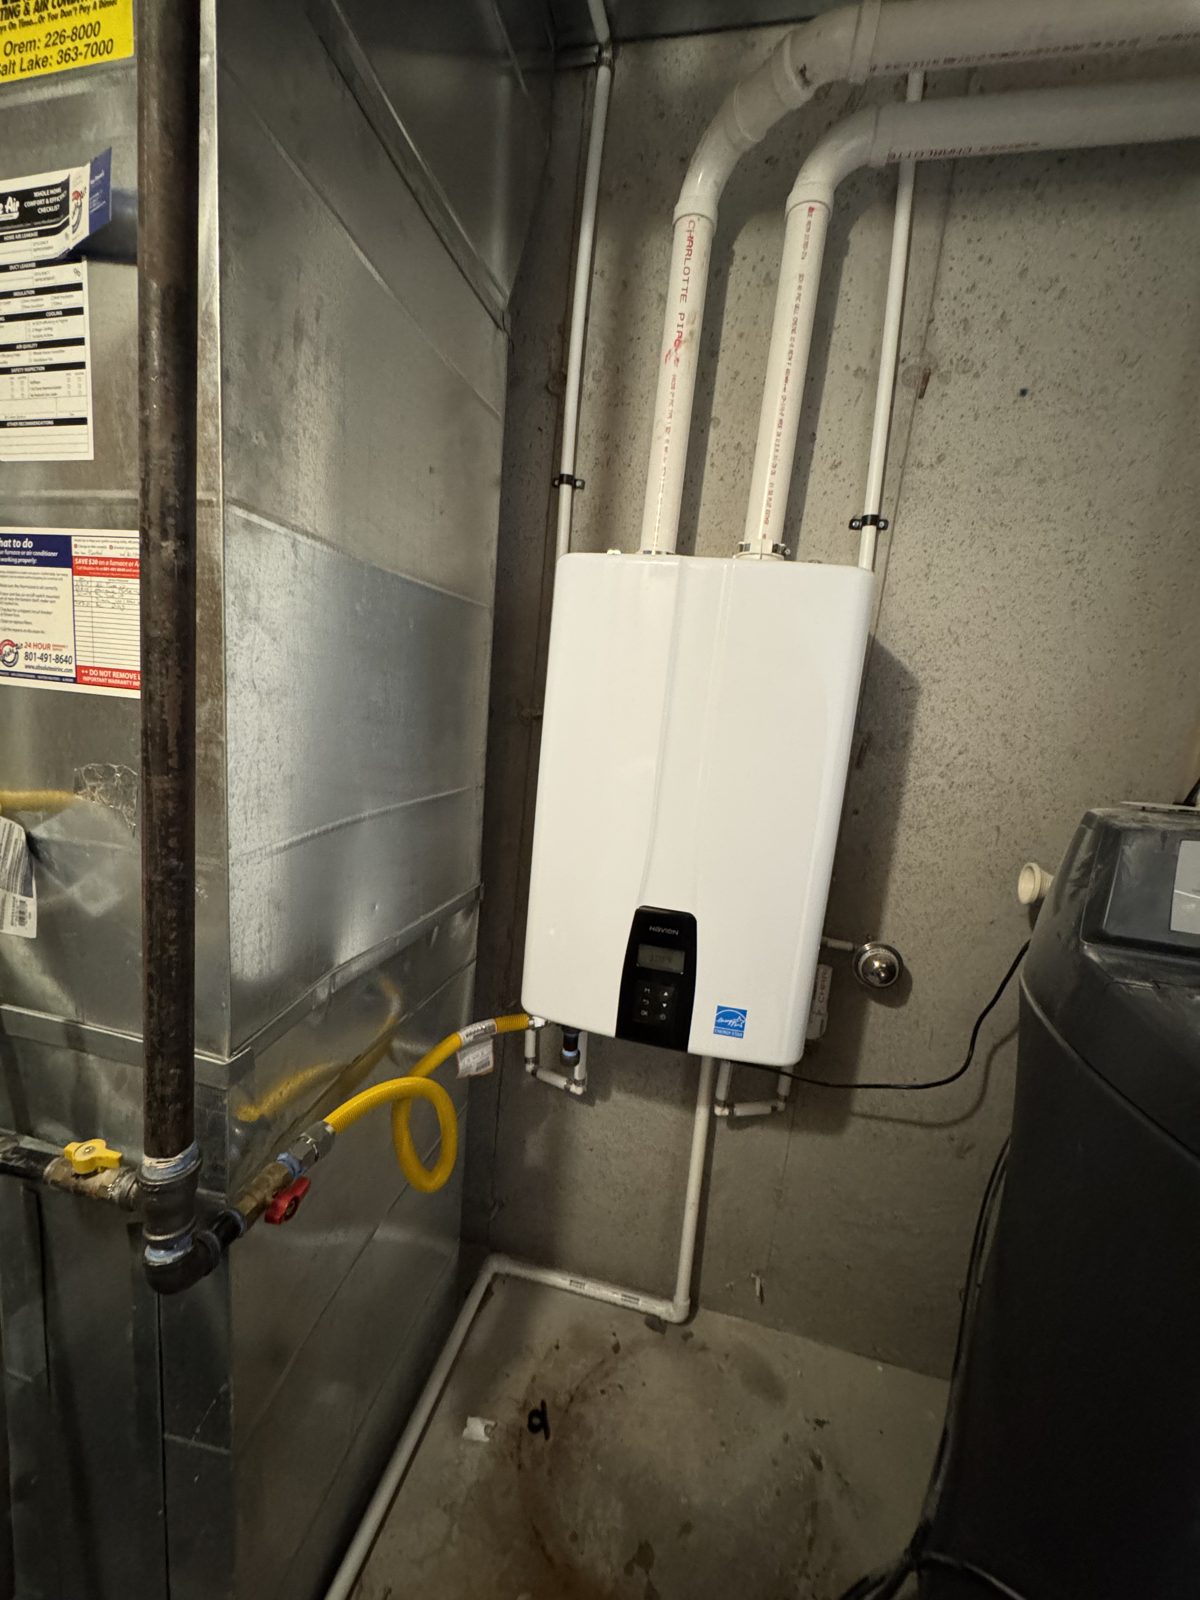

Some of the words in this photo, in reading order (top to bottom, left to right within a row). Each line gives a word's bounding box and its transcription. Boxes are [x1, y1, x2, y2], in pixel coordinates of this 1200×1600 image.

[4, 38, 41, 57] Orem:
[44, 20, 101, 48] 226-8000
[19, 54, 53, 73] Lake:
[56, 38, 114, 66] 363-7000
[5, 195, 20, 214] Air
[679, 219, 696, 304] CHARLOTTE
[12, 539, 22, 548] to
[22, 538, 33, 548] do
[75, 558, 88, 566] SAVE
[24, 641, 32, 649] 24
[32, 641, 51, 650] HOUR
[24, 651, 73, 664] 801-491-8640
[89, 668, 99, 676] DO
[99, 670, 111, 678] NOT
[112, 671, 138, 681] REMOVE
